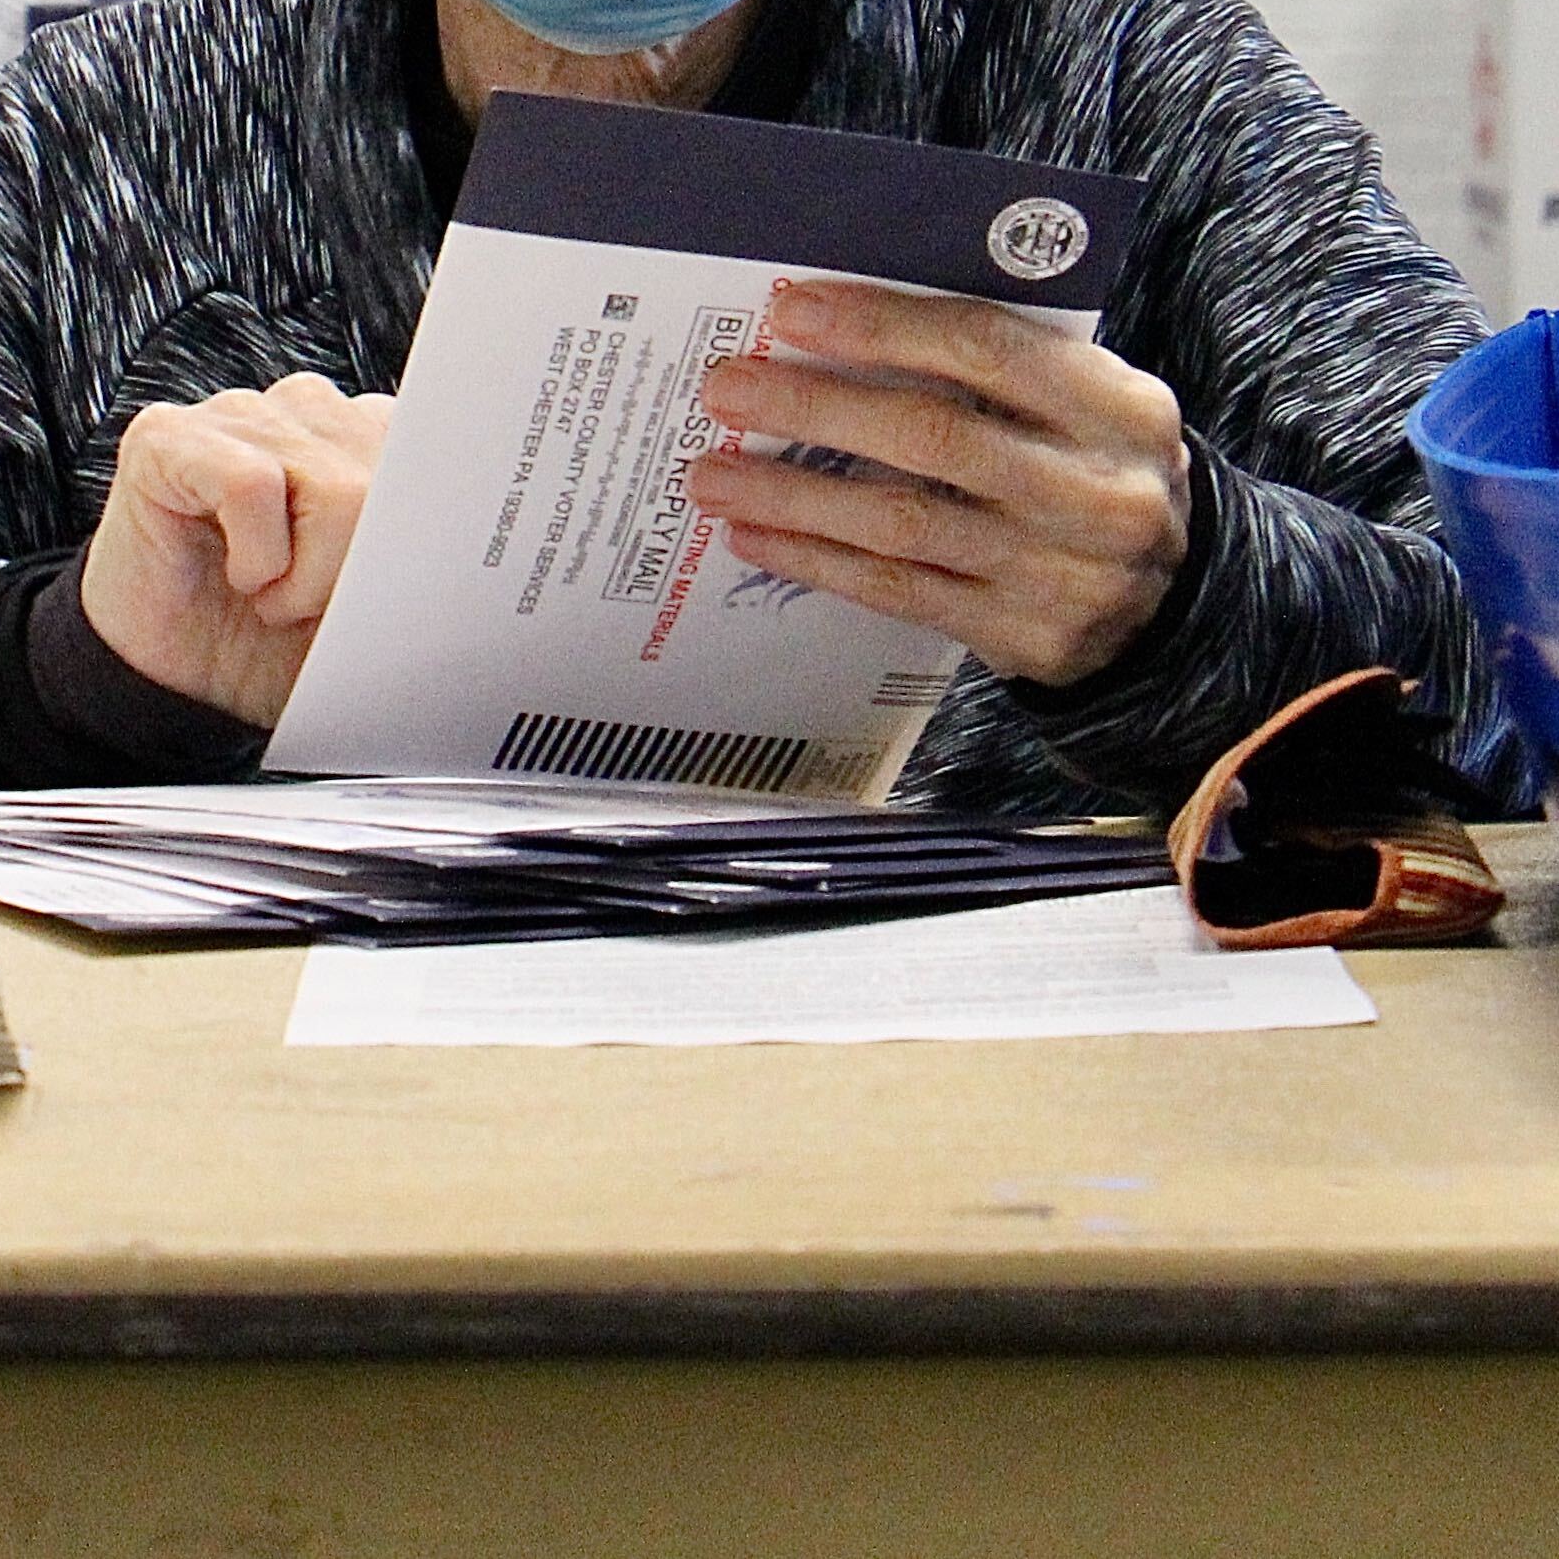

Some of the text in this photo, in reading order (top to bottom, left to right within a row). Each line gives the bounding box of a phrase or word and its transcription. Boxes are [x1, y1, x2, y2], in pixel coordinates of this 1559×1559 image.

[545, 325, 576, 375] WEST
[553, 328, 601, 433] PO BOX 2747
[677, 316, 743, 451] BUSSS
[519, 378, 559, 457] CHESTER
[511, 461, 534, 484] PA
[515, 331, 627, 615] CHESTER COUNTY VOTER SERVICES
[626, 545, 668, 597] MAIL
[638, 578, 692, 663] MATERIALS
